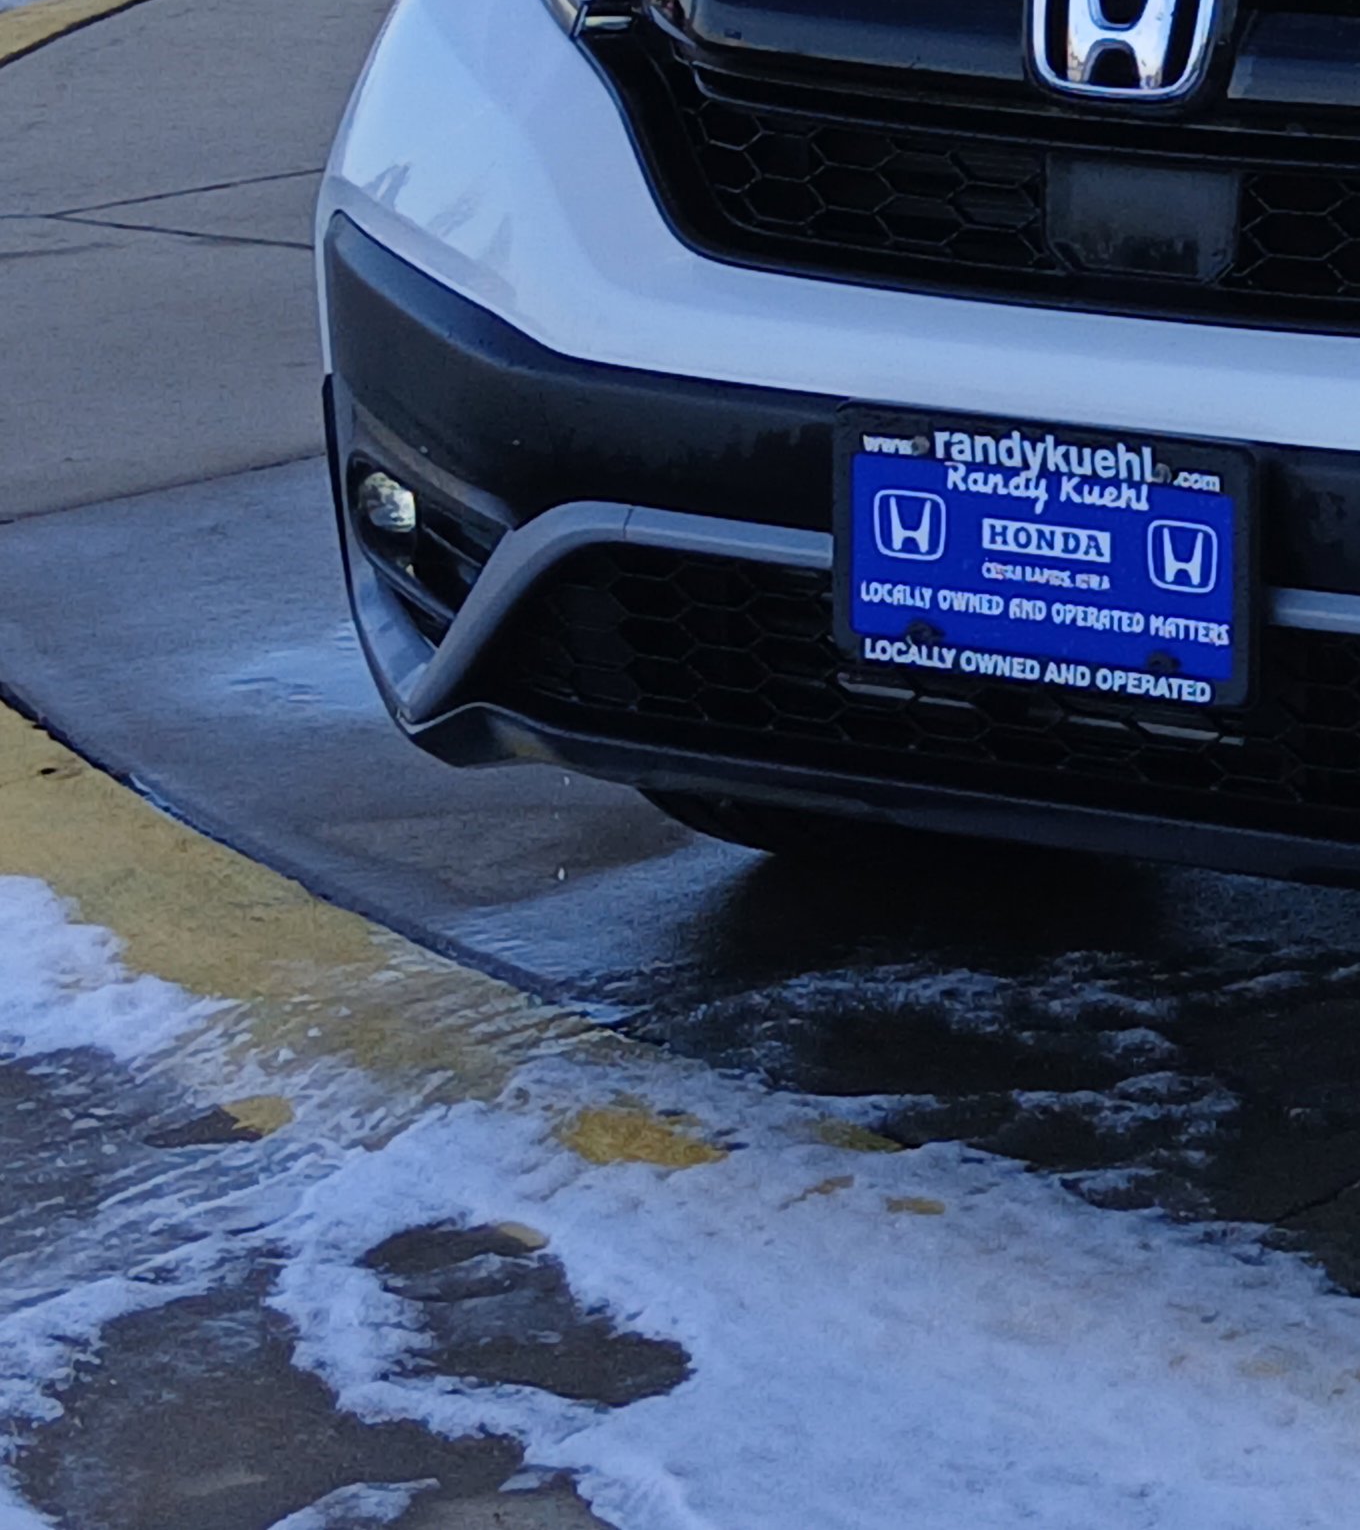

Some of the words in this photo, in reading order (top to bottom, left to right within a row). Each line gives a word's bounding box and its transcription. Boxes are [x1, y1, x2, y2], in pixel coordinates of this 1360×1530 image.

[945, 462, 1048, 514] Randy
[1059, 476, 1149, 512] Kuehl
[988, 523, 1105, 558] HONDA
[861, 580, 933, 609] LOCALLY
[937, 589, 1004, 615] OWNED
[1009, 598, 1047, 621] AND
[1051, 602, 1145, 633] OPERATED
[1150, 614, 1230, 646] MATTERS
[864, 637, 957, 669] LOCALLY
[960, 650, 1041, 680] OWNED
[1044, 661, 1092, 687] AND
[1095, 668, 1212, 703] OPERATED
